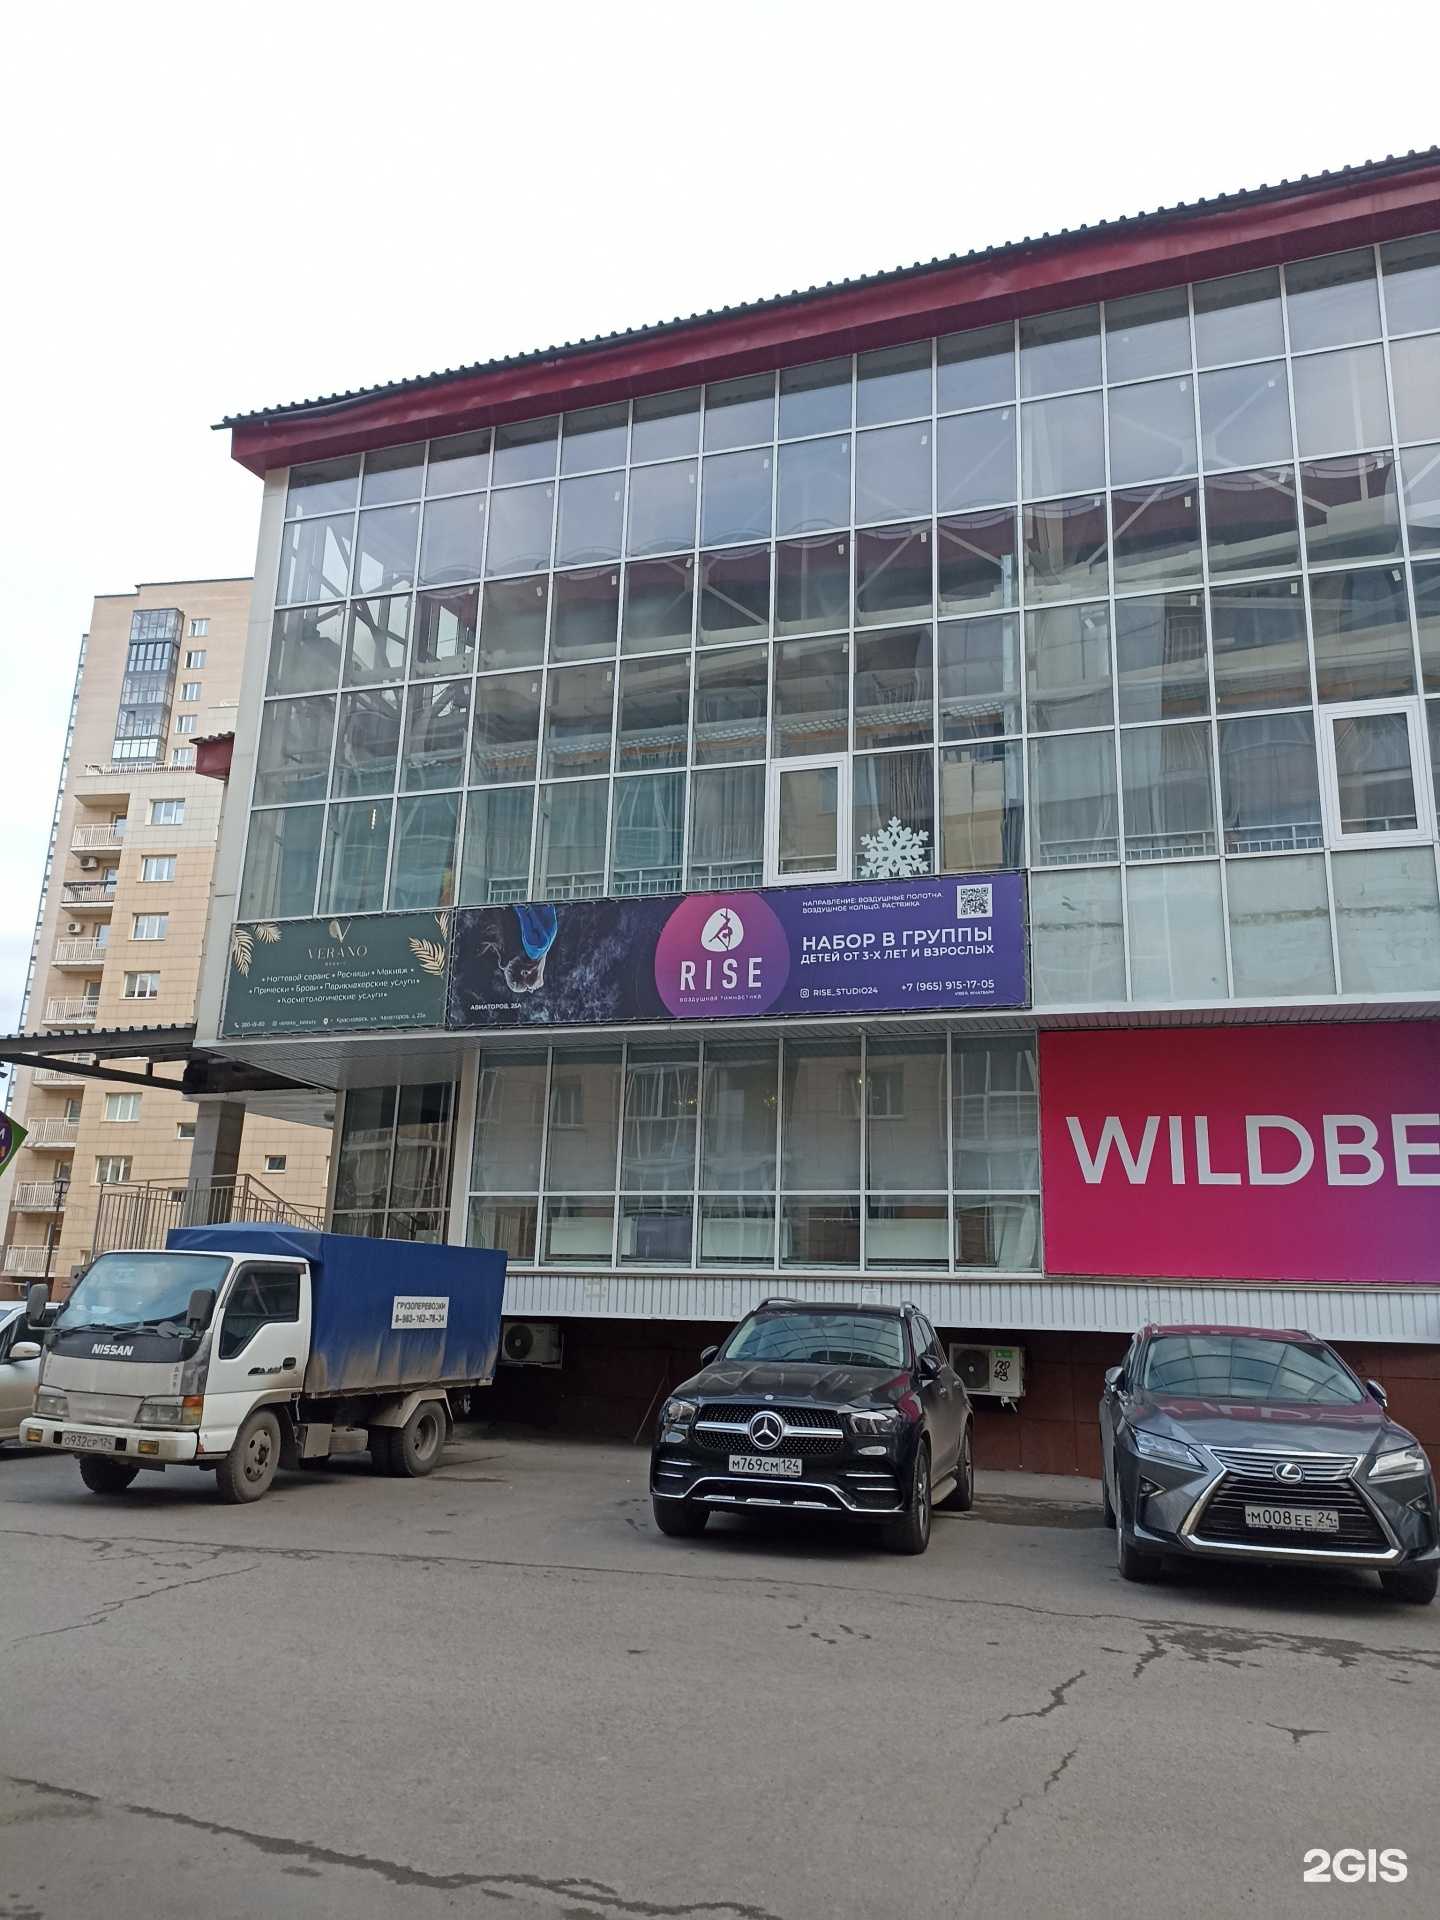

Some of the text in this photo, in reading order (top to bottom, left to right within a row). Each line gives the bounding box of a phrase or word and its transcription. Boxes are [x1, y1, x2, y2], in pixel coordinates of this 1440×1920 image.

[802, 905, 847, 914] ВОЗДУШНОЕ
[802, 926, 992, 951] НАБОР В ГРУППЫ
[800, 944, 995, 965] ДЕТЕЙ ОТ 3-Х ЛЕТ И ВЗРОСЛЫХ
[680, 957, 762, 991] RISE
[813, 979, 995, 997] RISE_STUDIO24 +7 (965) 915-17-05
[1065, 1113, 1440, 1186] WILDBE
[91, 1343, 134, 1356] NISSAN
[781, 1459, 799, 1471] 124
[1318, 1511, 1333, 1524] 24
